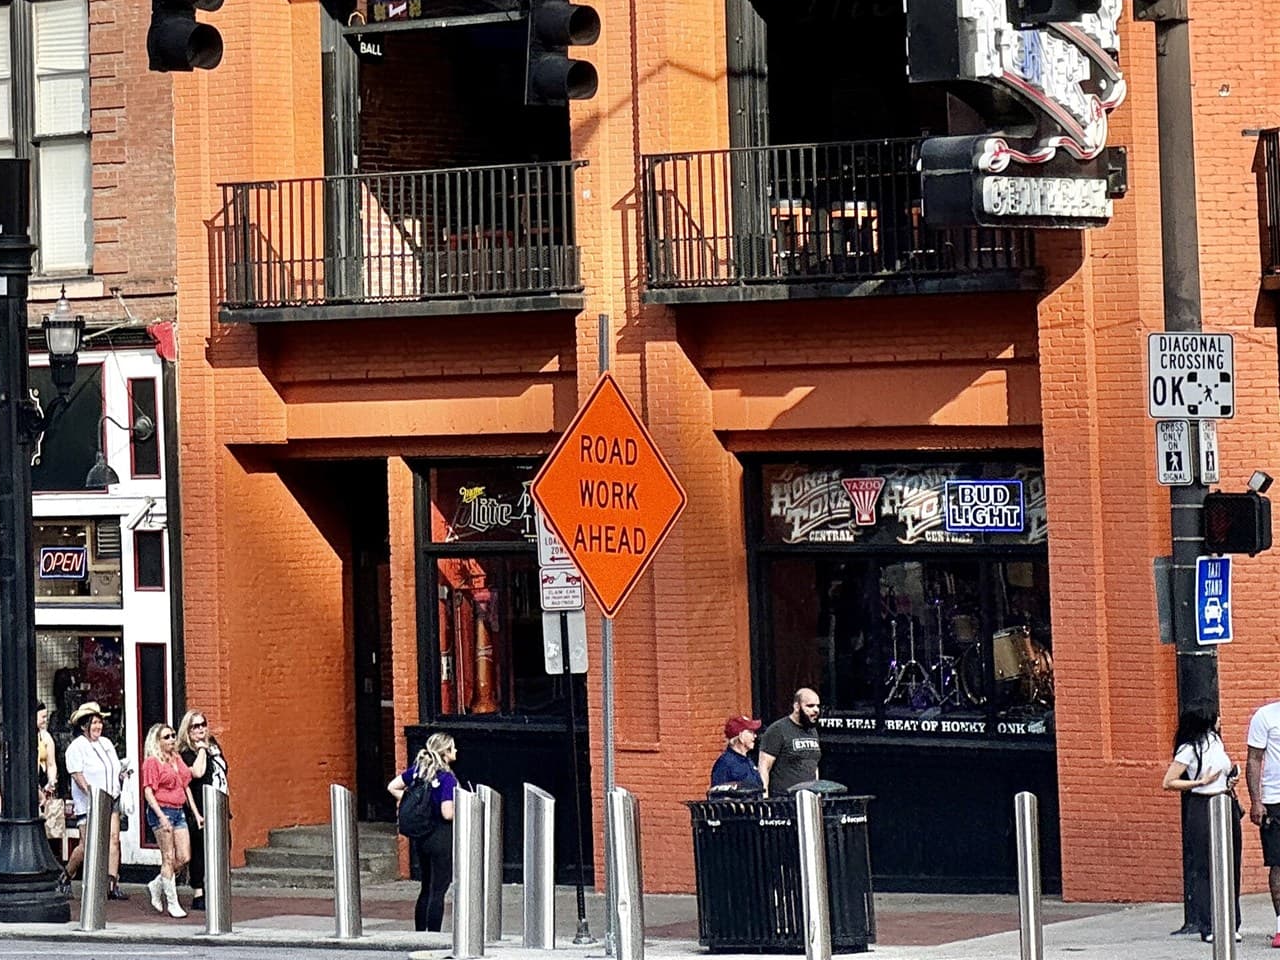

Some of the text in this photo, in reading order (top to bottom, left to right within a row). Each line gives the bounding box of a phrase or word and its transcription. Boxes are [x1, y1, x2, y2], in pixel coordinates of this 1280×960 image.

[360, 42, 382, 56] BALL
[1159, 336, 1225, 352] DIAGONAL
[1160, 354, 1224, 369] CROSSING
[1152, 375, 1185, 406] OK
[1160, 422, 1185, 433] CROSS
[1162, 432, 1183, 442] ONLY
[580, 434, 638, 466] ROAD
[1168, 441, 1179, 451] ON
[845, 479, 883, 491] YAZOO
[1162, 472, 1187, 482] SIGNAL
[579, 479, 639, 510] WORK
[958, 484, 1010, 507] BUD
[469, 496, 513, 533] Lite
[948, 505, 1018, 527] LIGHT
[573, 524, 646, 555] AHEAD
[808, 530, 855, 542] CENTRAL
[551, 546, 567, 555] ZON
[42, 551, 84, 573] OPEN
[1207, 562, 1221, 578] TAXI
[1204, 578, 1223, 597] STAND
[819, 718, 844, 728] THE
[921, 720, 938, 731] OF
[941, 720, 987, 733] HONKY
